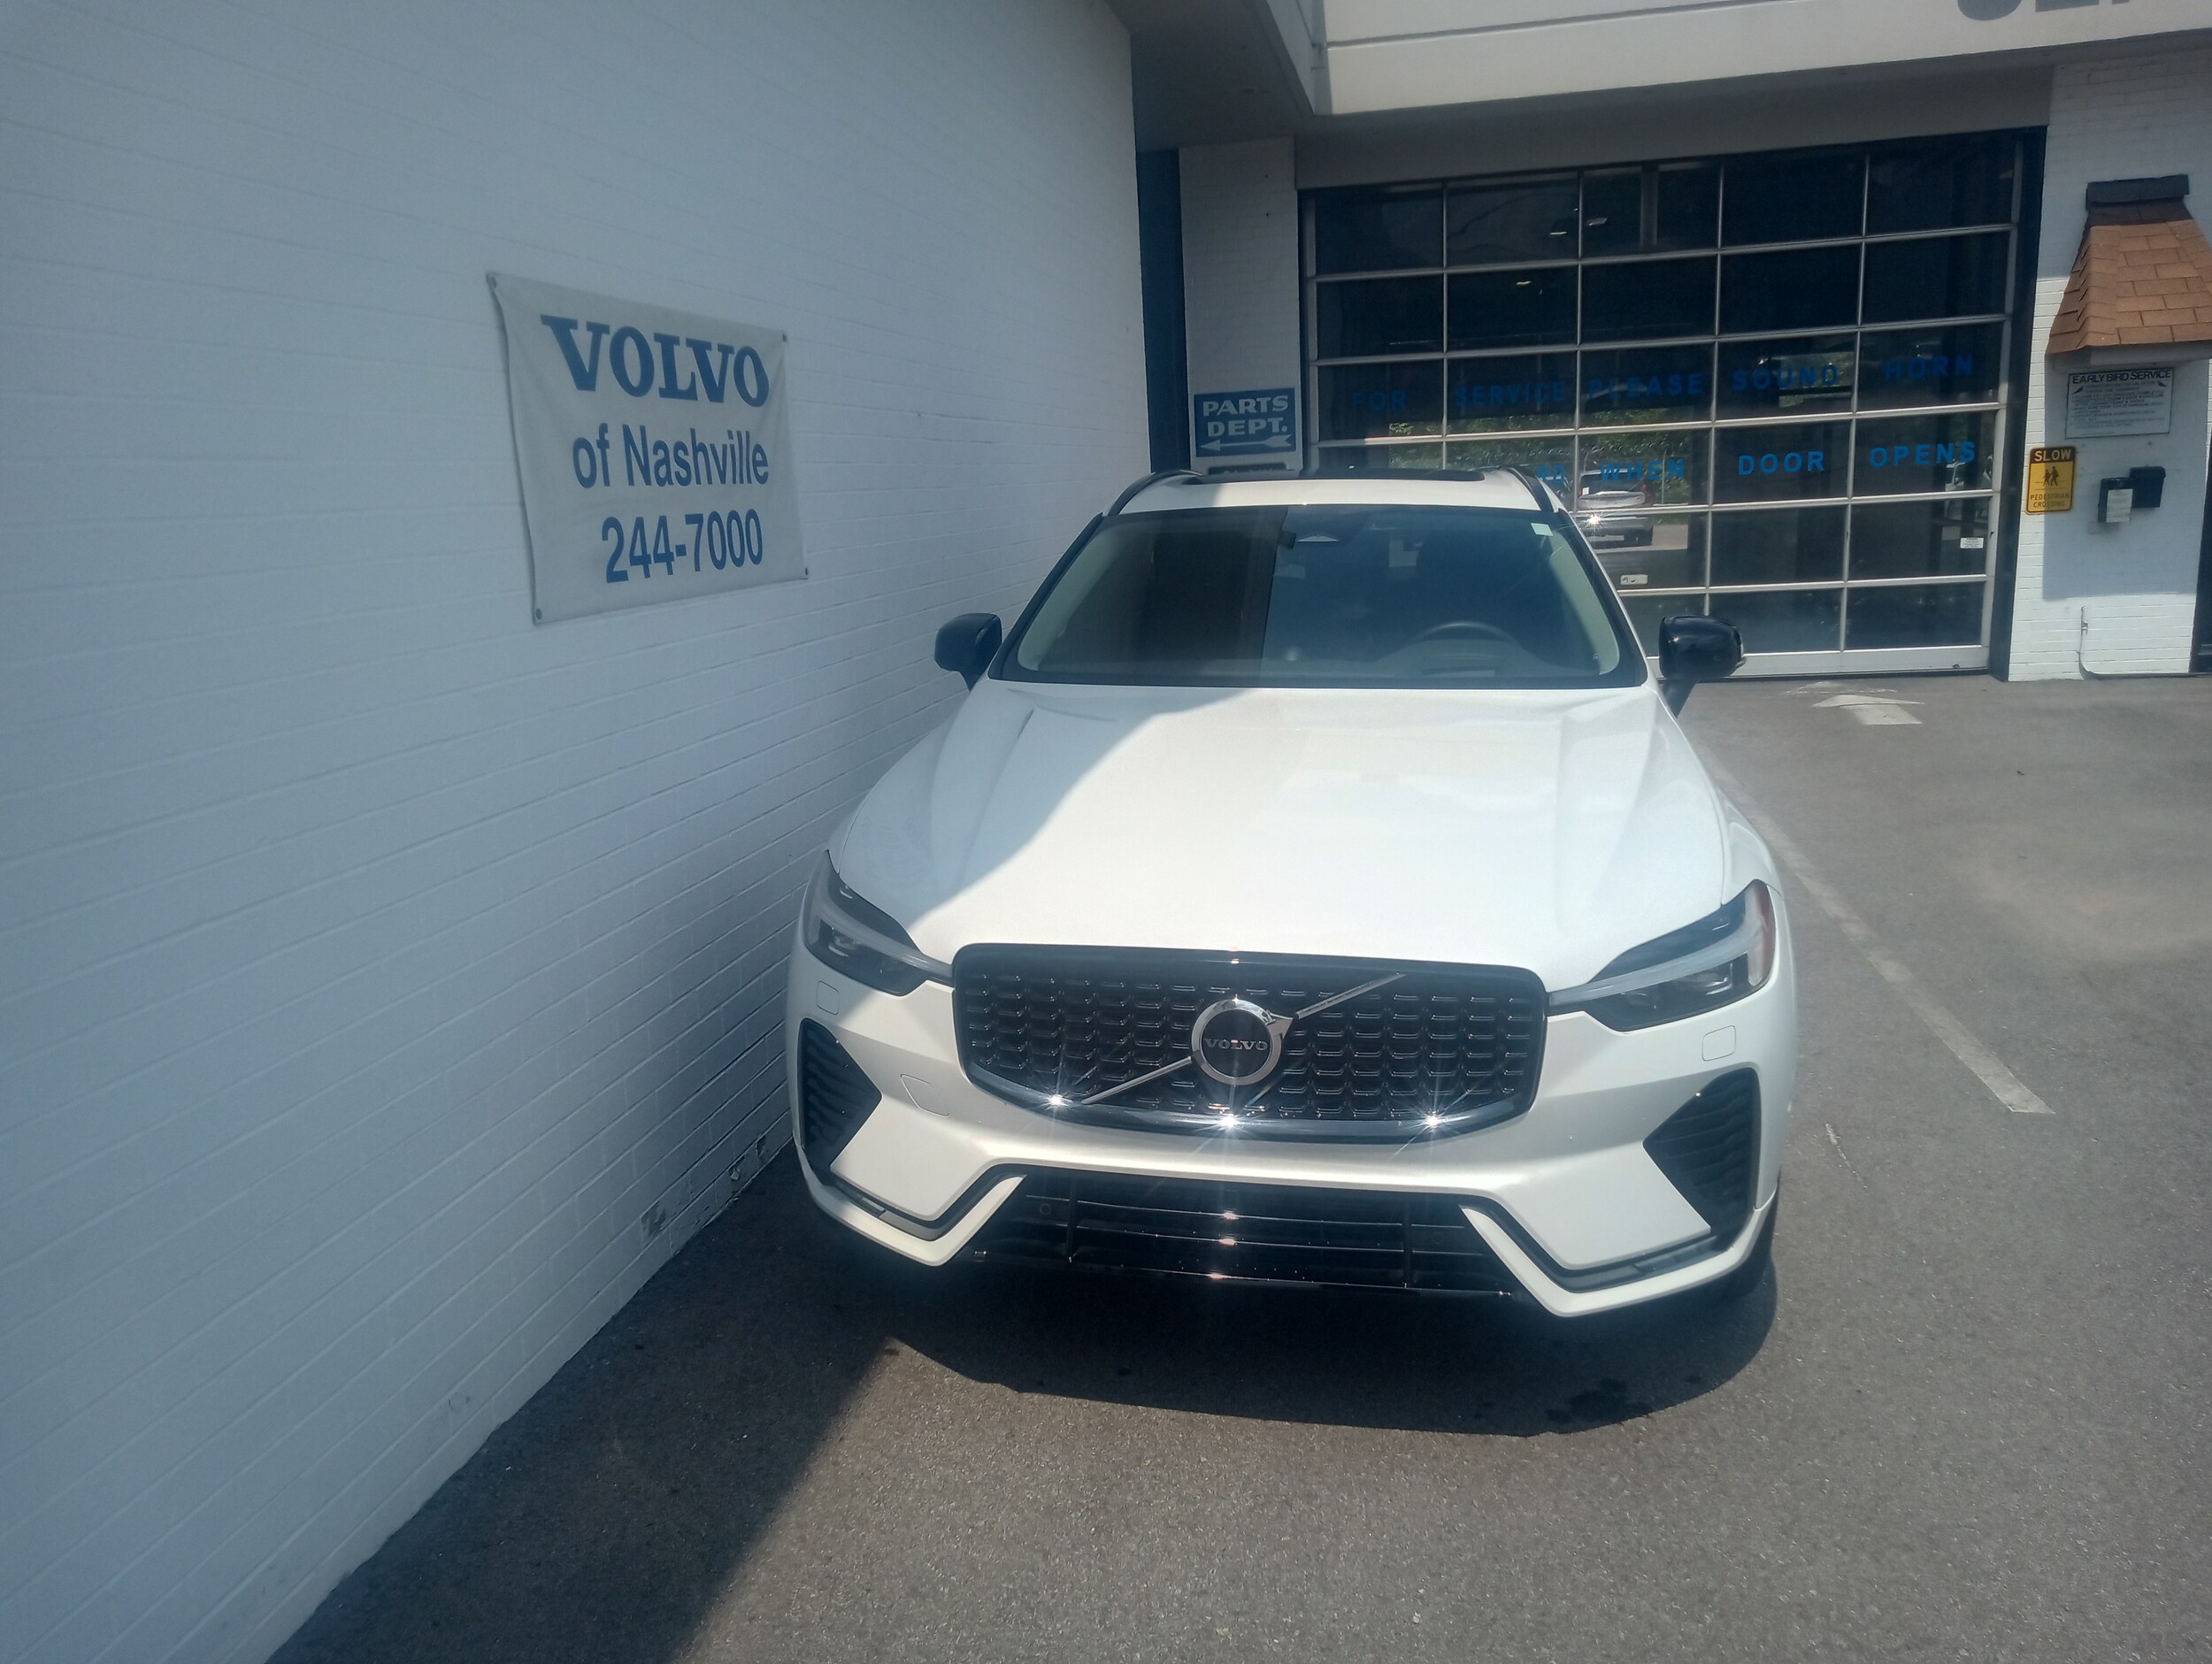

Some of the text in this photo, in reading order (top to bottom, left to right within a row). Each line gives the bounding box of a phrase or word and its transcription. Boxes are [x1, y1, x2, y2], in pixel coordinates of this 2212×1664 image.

[540, 314, 770, 408] VOLVO
[1352, 355, 1973, 411] FOR SERVICE PLEASE SOUND HORN
[2072, 370, 2171, 384] EARLY BIRD SERVICE
[1203, 395, 1289, 417] PARTS
[1207, 417, 1288, 437] DEPT.
[572, 423, 769, 489] of Nashville
[1600, 457, 1686, 483] WHEN
[1738, 450, 1825, 476] DOOR
[1870, 441, 1977, 468] OPENS
[2035, 449, 2071, 462] SLOW
[2030, 492, 2070, 502] PEDESTRIAN
[2032, 500, 2066, 509] CROSSING
[601, 509, 764, 584] 244-7000
[1204, 1038, 1269, 1051] VOLVO
